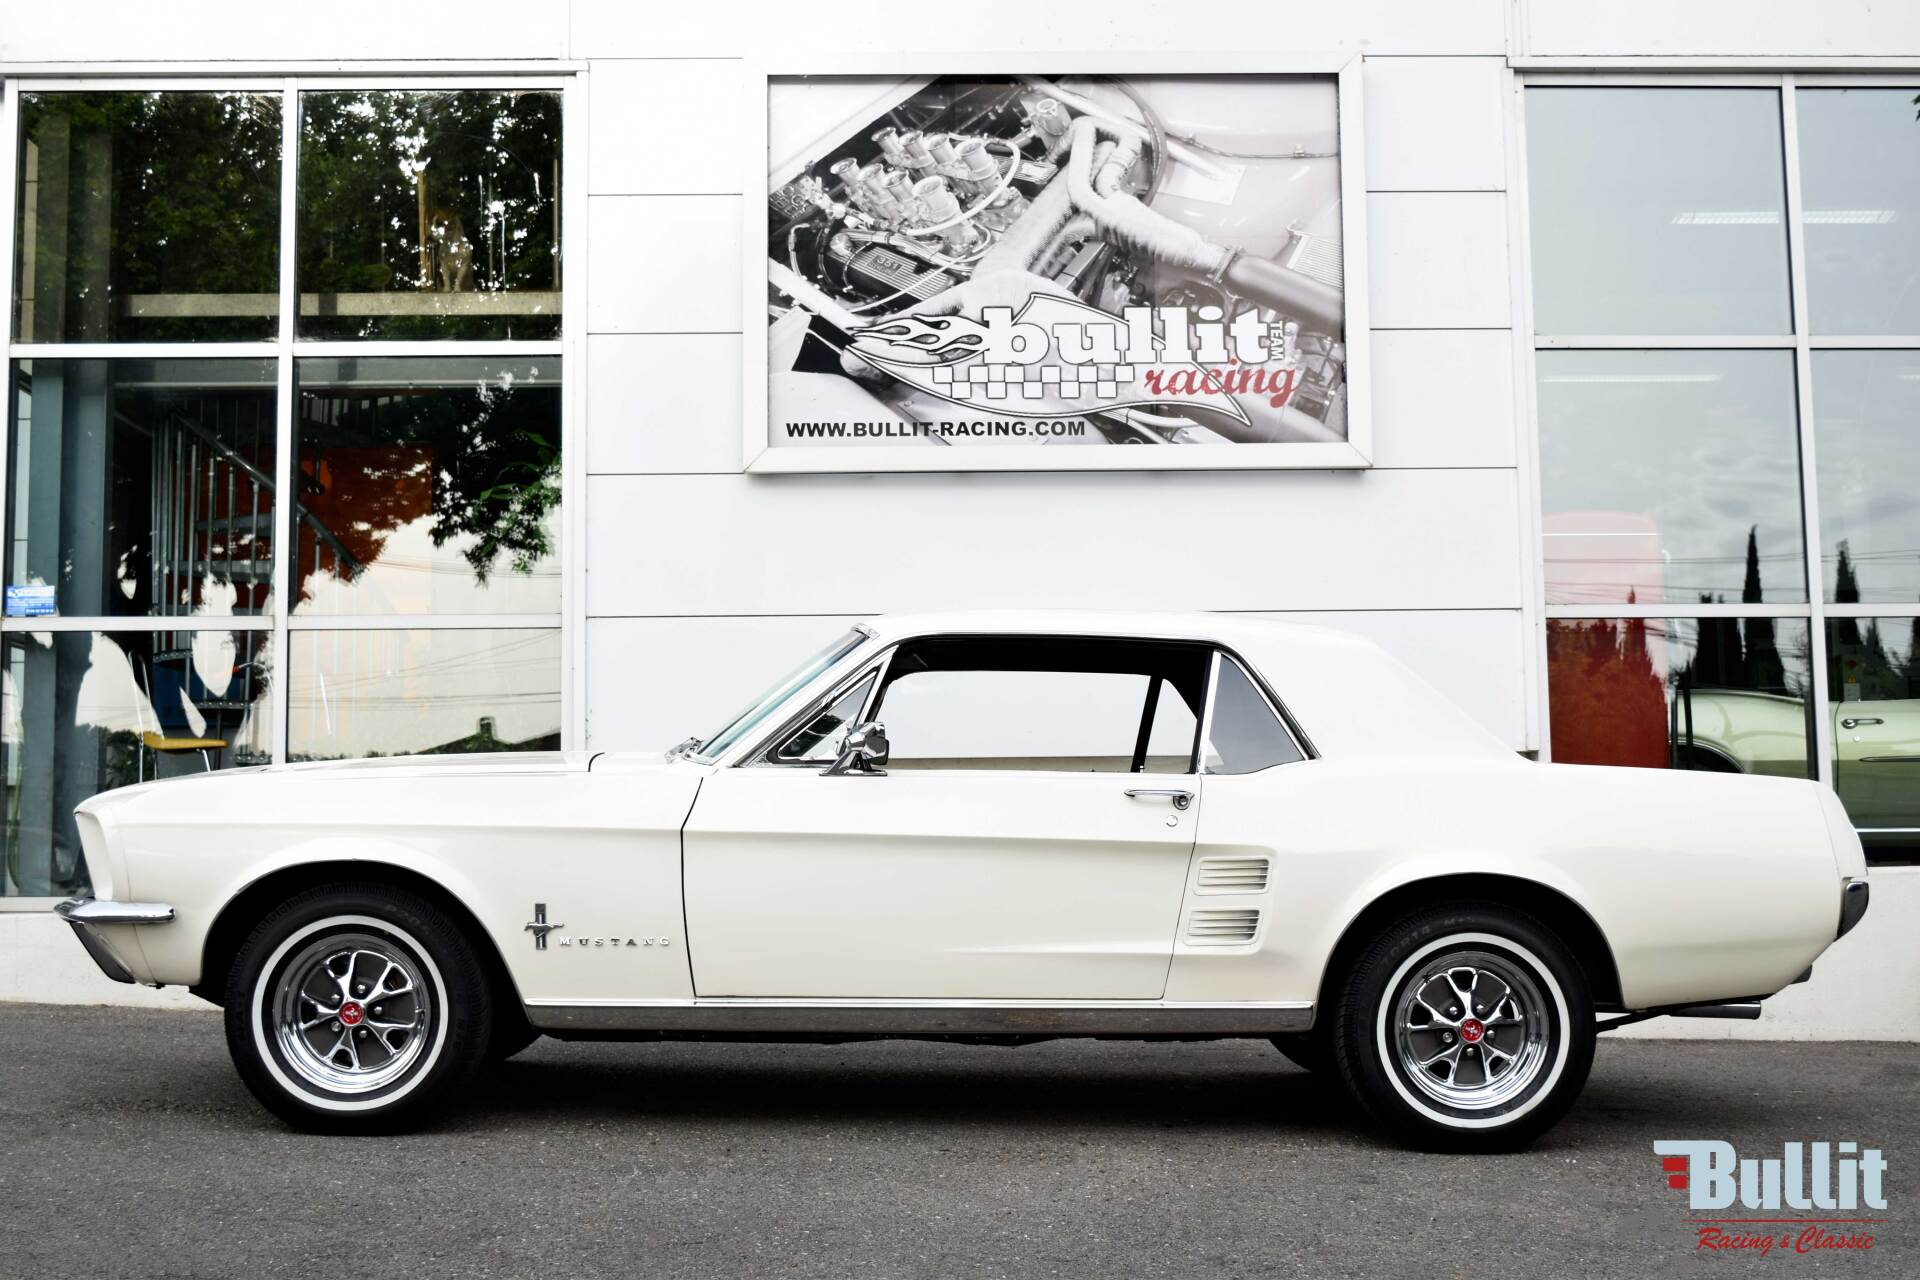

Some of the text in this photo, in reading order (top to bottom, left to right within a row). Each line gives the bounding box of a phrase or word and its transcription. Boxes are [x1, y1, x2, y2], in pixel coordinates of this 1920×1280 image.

[982, 306, 1269, 365] bullit
[1270, 320, 1284, 361] TEAM
[1144, 358, 1300, 408] racing
[786, 421, 1086, 437] WWW.BULLIT-RACING.COM
[559, 936, 670, 947] MUSTANG
